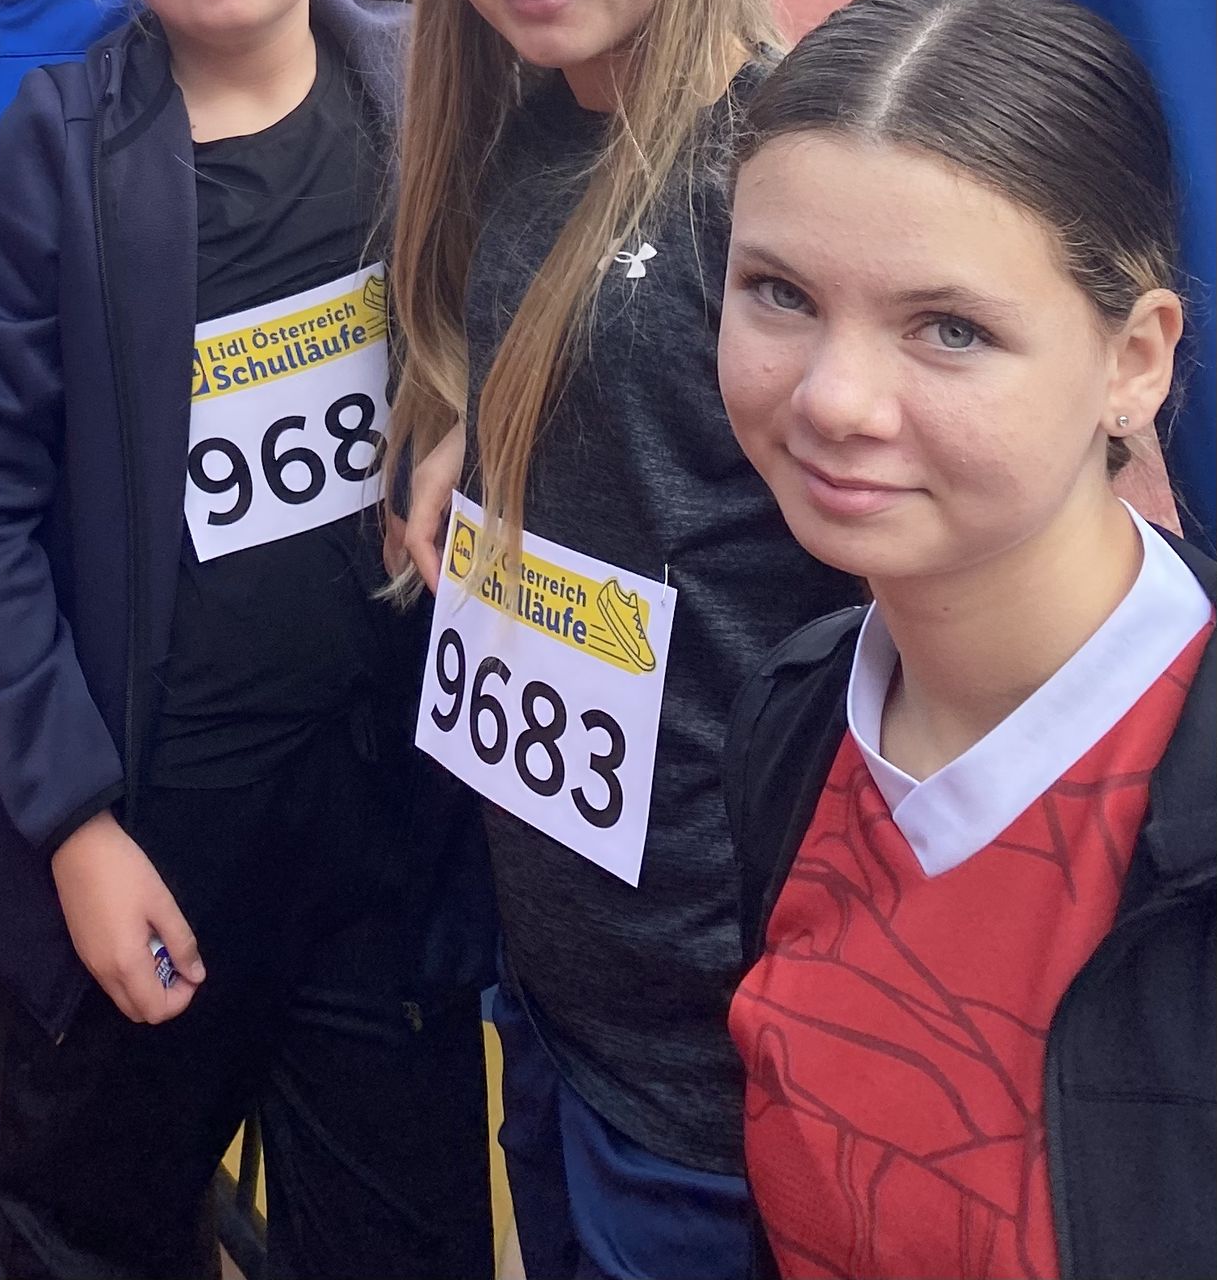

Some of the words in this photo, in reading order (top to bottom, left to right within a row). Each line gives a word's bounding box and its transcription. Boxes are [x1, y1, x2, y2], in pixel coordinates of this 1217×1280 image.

[207, 336, 248, 363] Lidl
[251, 302, 357, 350] Österreich
[212, 323, 367, 391] Schulläufe
[188, 393, 391, 526] 968
[481, 570, 588, 646] chlläufe
[430, 628, 627, 829] 9683
